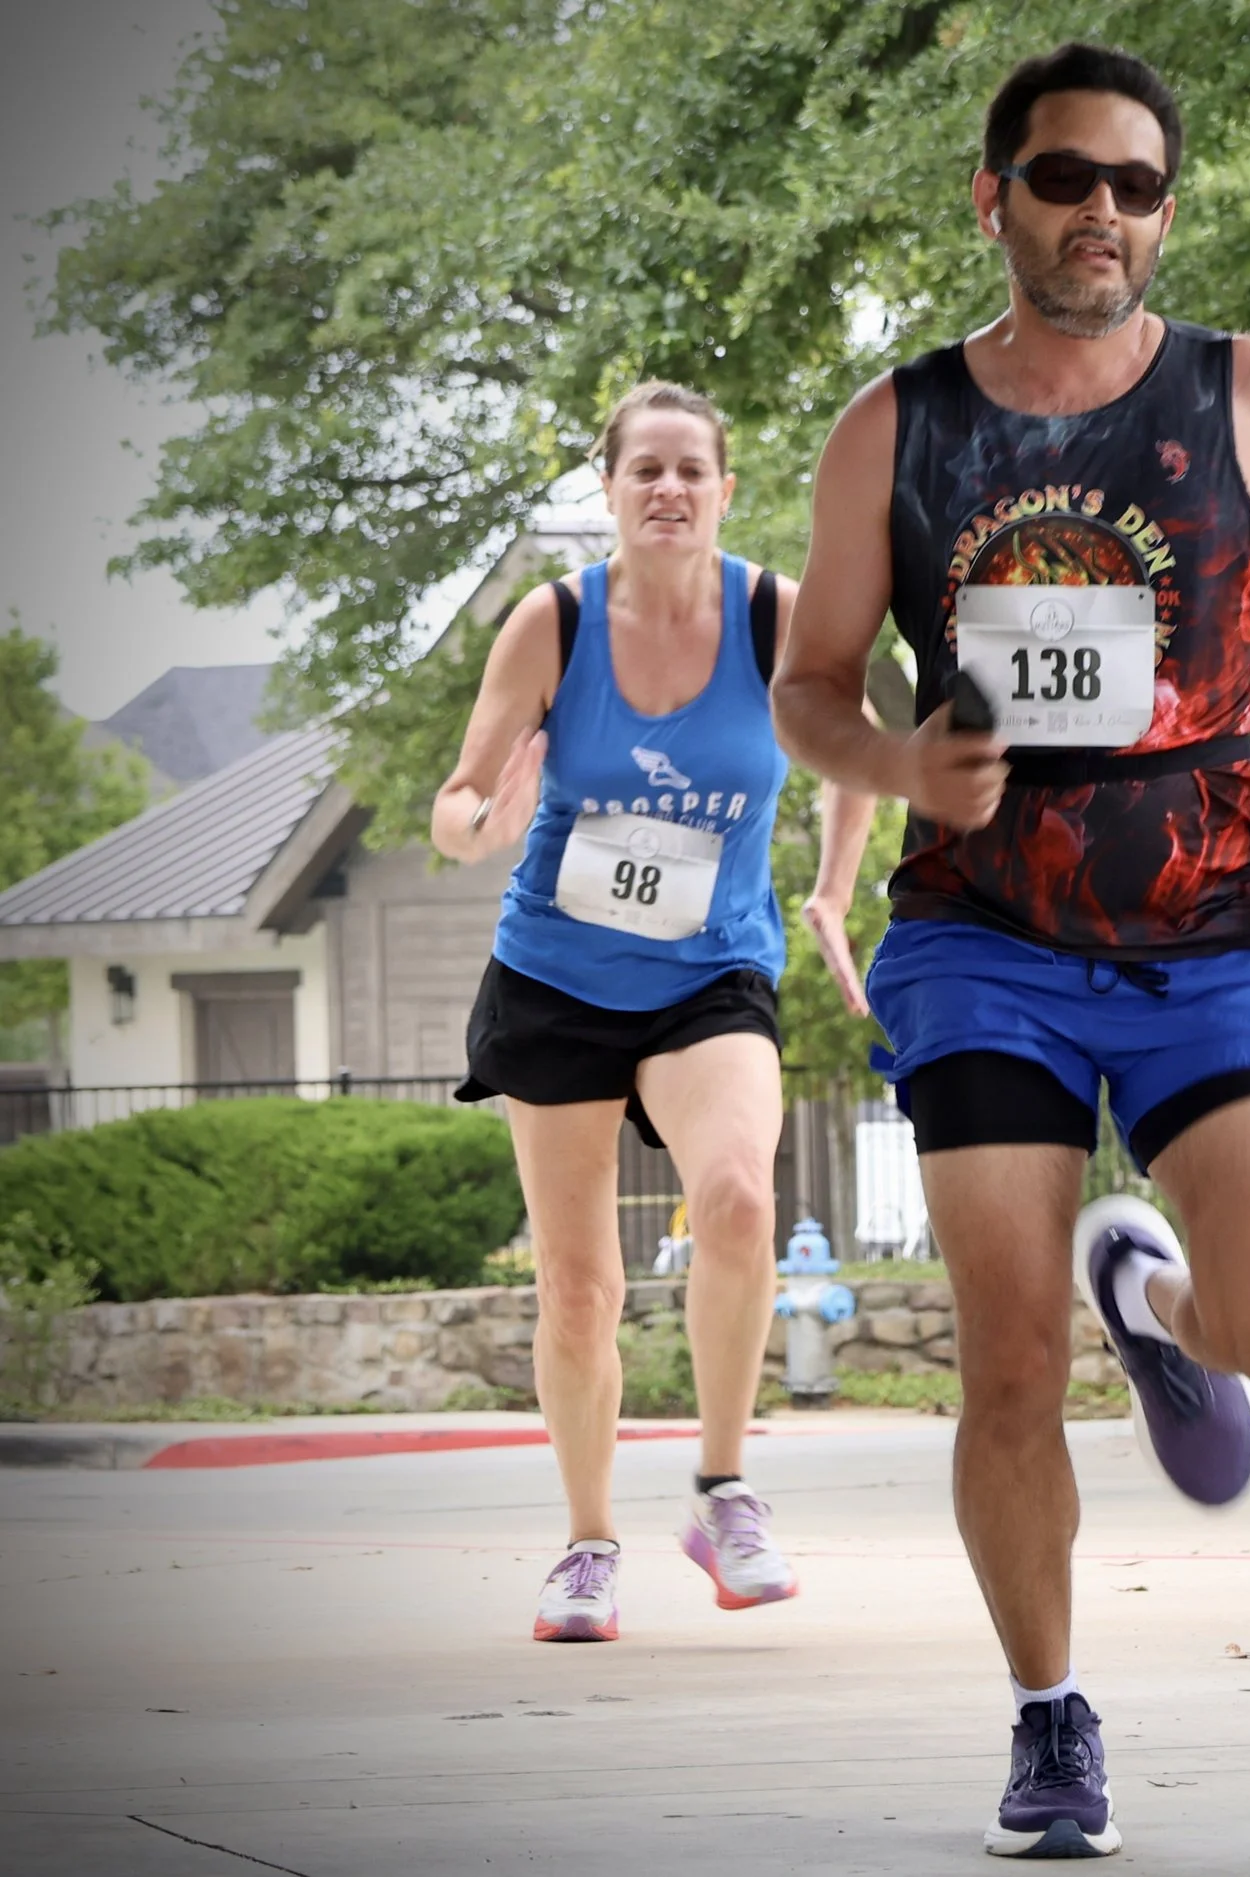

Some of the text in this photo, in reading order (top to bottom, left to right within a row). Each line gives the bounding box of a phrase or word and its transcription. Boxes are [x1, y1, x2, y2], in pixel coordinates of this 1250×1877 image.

[949, 484, 1177, 583] DRAGON'S DEN
[1011, 647, 1101, 701] 138
[611, 860, 661, 905] 98
